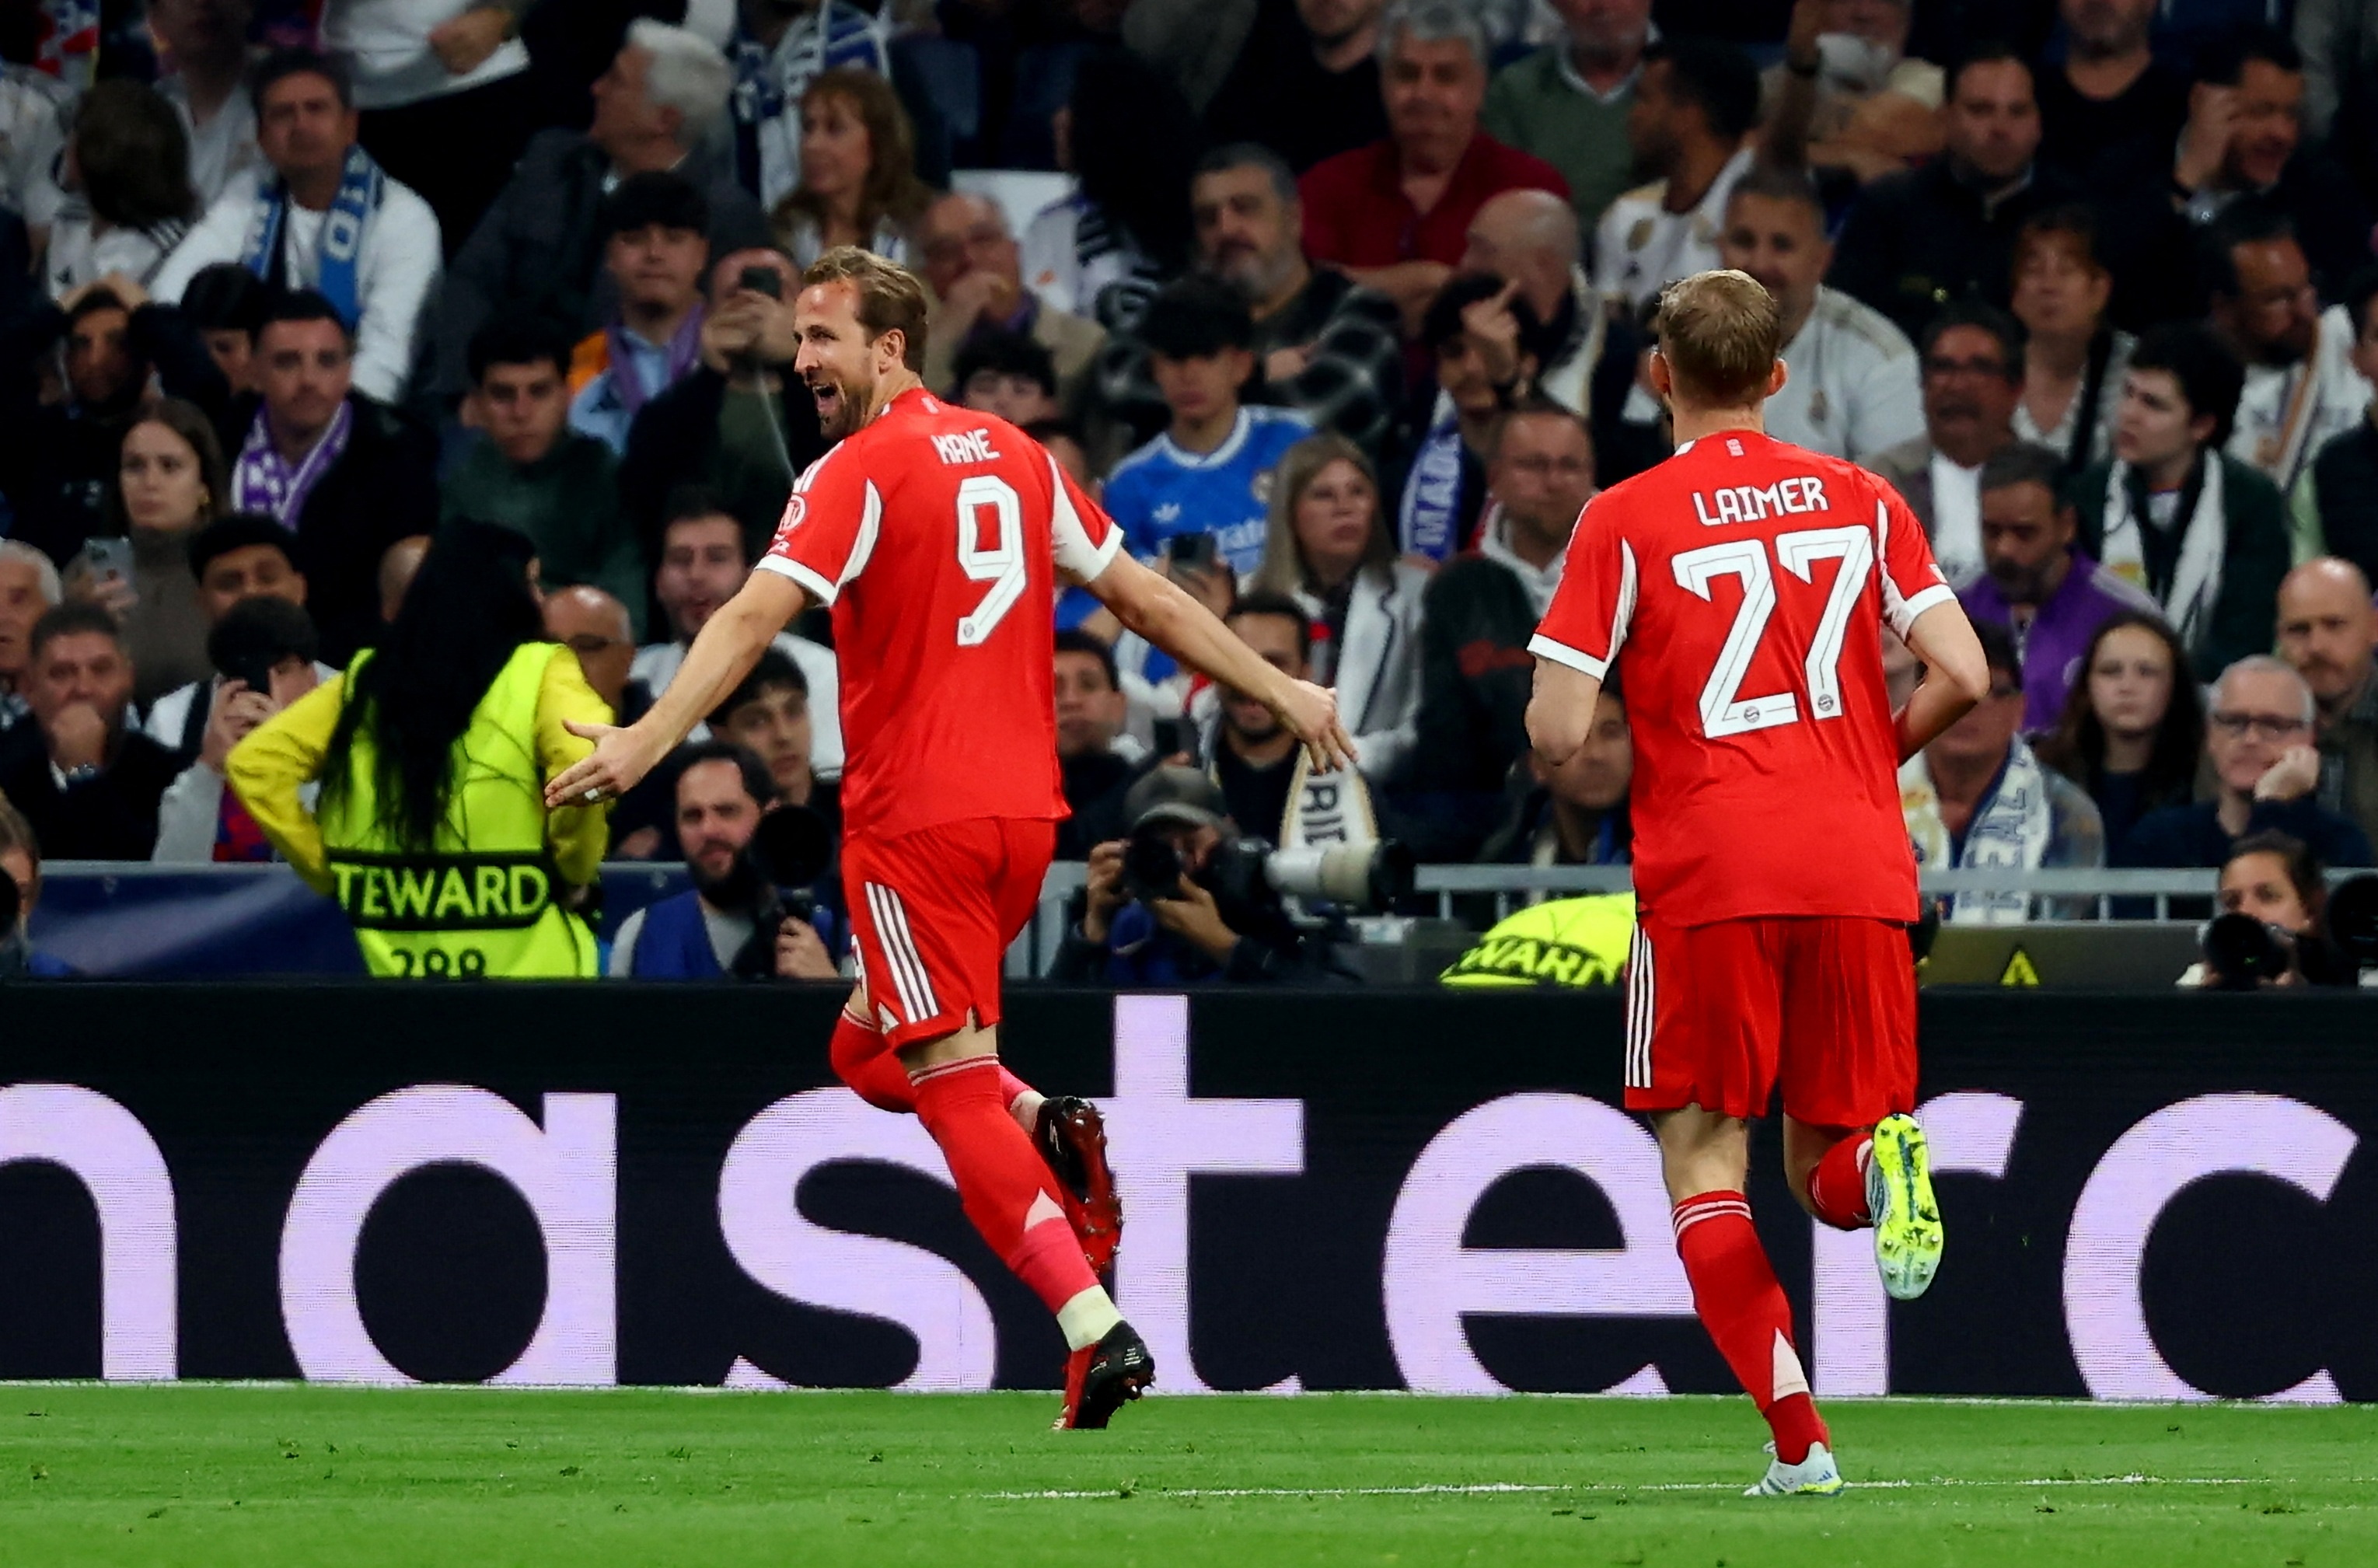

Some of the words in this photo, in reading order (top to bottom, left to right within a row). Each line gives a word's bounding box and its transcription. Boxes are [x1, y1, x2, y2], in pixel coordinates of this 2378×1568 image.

[931, 428, 1000, 465] KANE
[1692, 477, 1828, 526] LAIMER
[956, 474, 1026, 647] 9
[1671, 524, 1874, 739] 27
[330, 861, 549, 918] TEWARD
[1440, 939, 1616, 987] WARD
